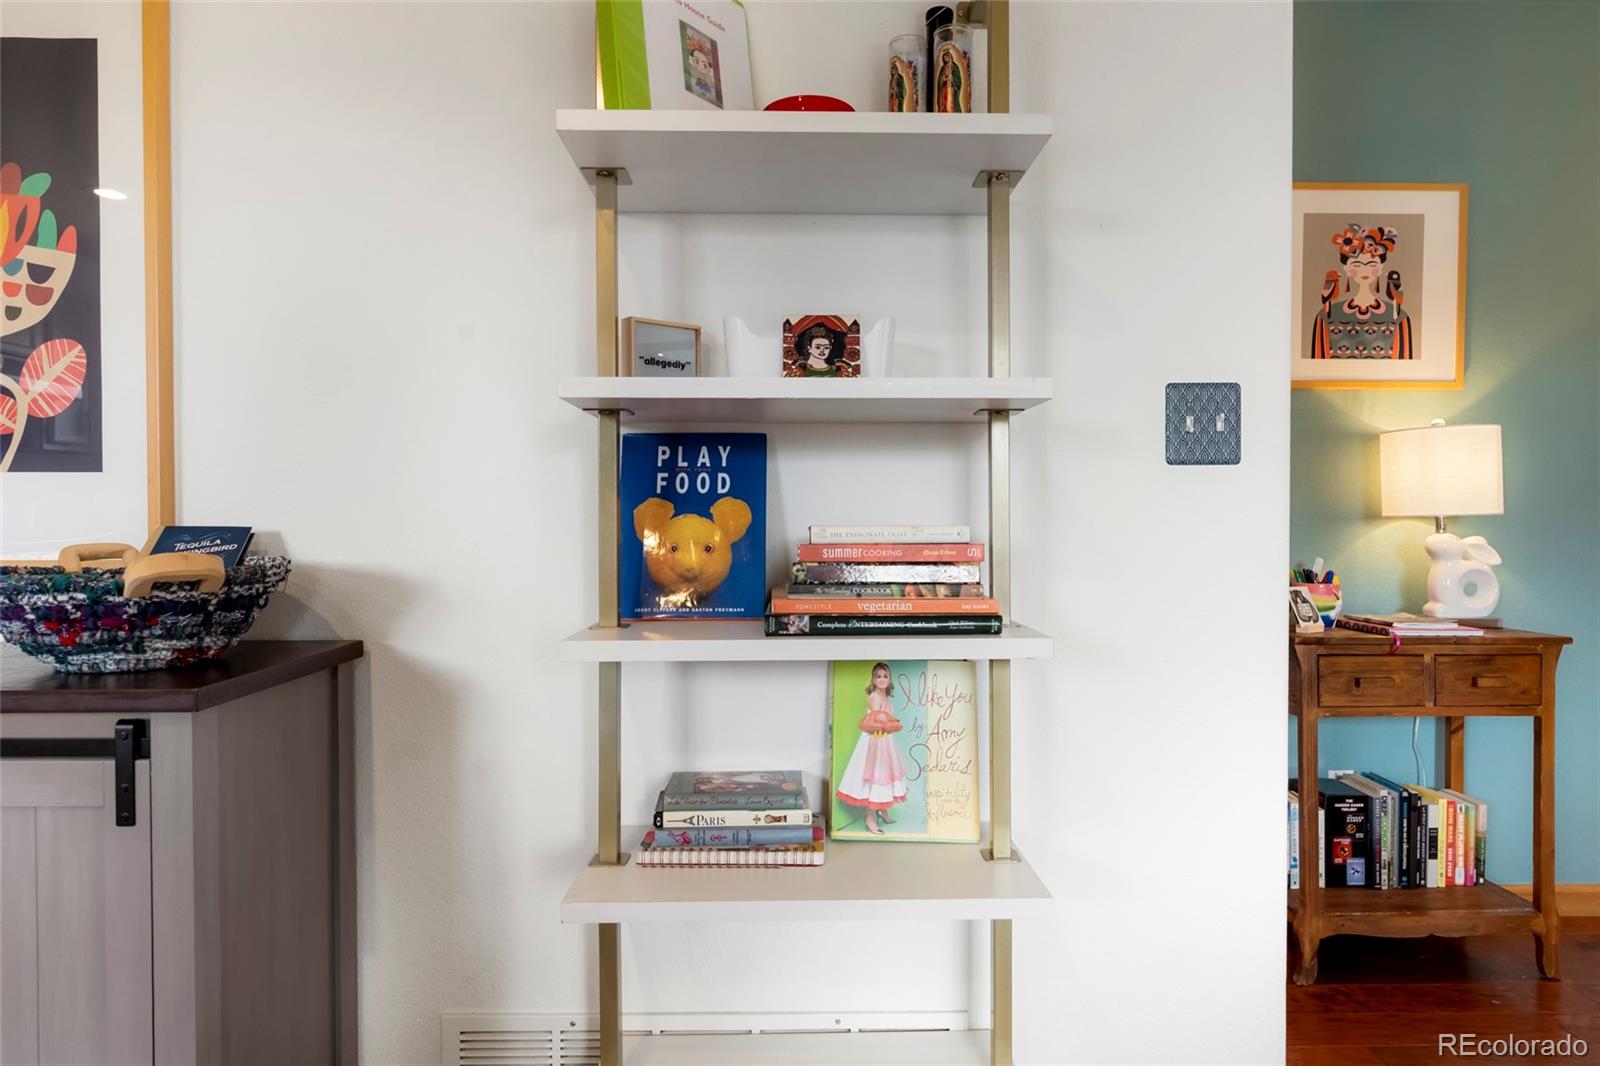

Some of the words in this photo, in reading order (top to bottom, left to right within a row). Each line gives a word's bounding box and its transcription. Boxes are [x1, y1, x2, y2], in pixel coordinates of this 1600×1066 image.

[684, 1, 705, 20] House
[706, 15, 726, 32] Guide
[657, 445, 731, 467] PLAY
[656, 472, 731, 494] FOOD
[174, 538, 222, 552] TEQUILA
[857, 601, 912, 613] vegetarian
[817, 621, 847, 629] Complete
[943, 682, 975, 721] You
[908, 717, 926, 736] by
[925, 715, 966, 759] Amy
[906, 743, 973, 782] Sedaris
[696, 814, 726, 826] PARIS
